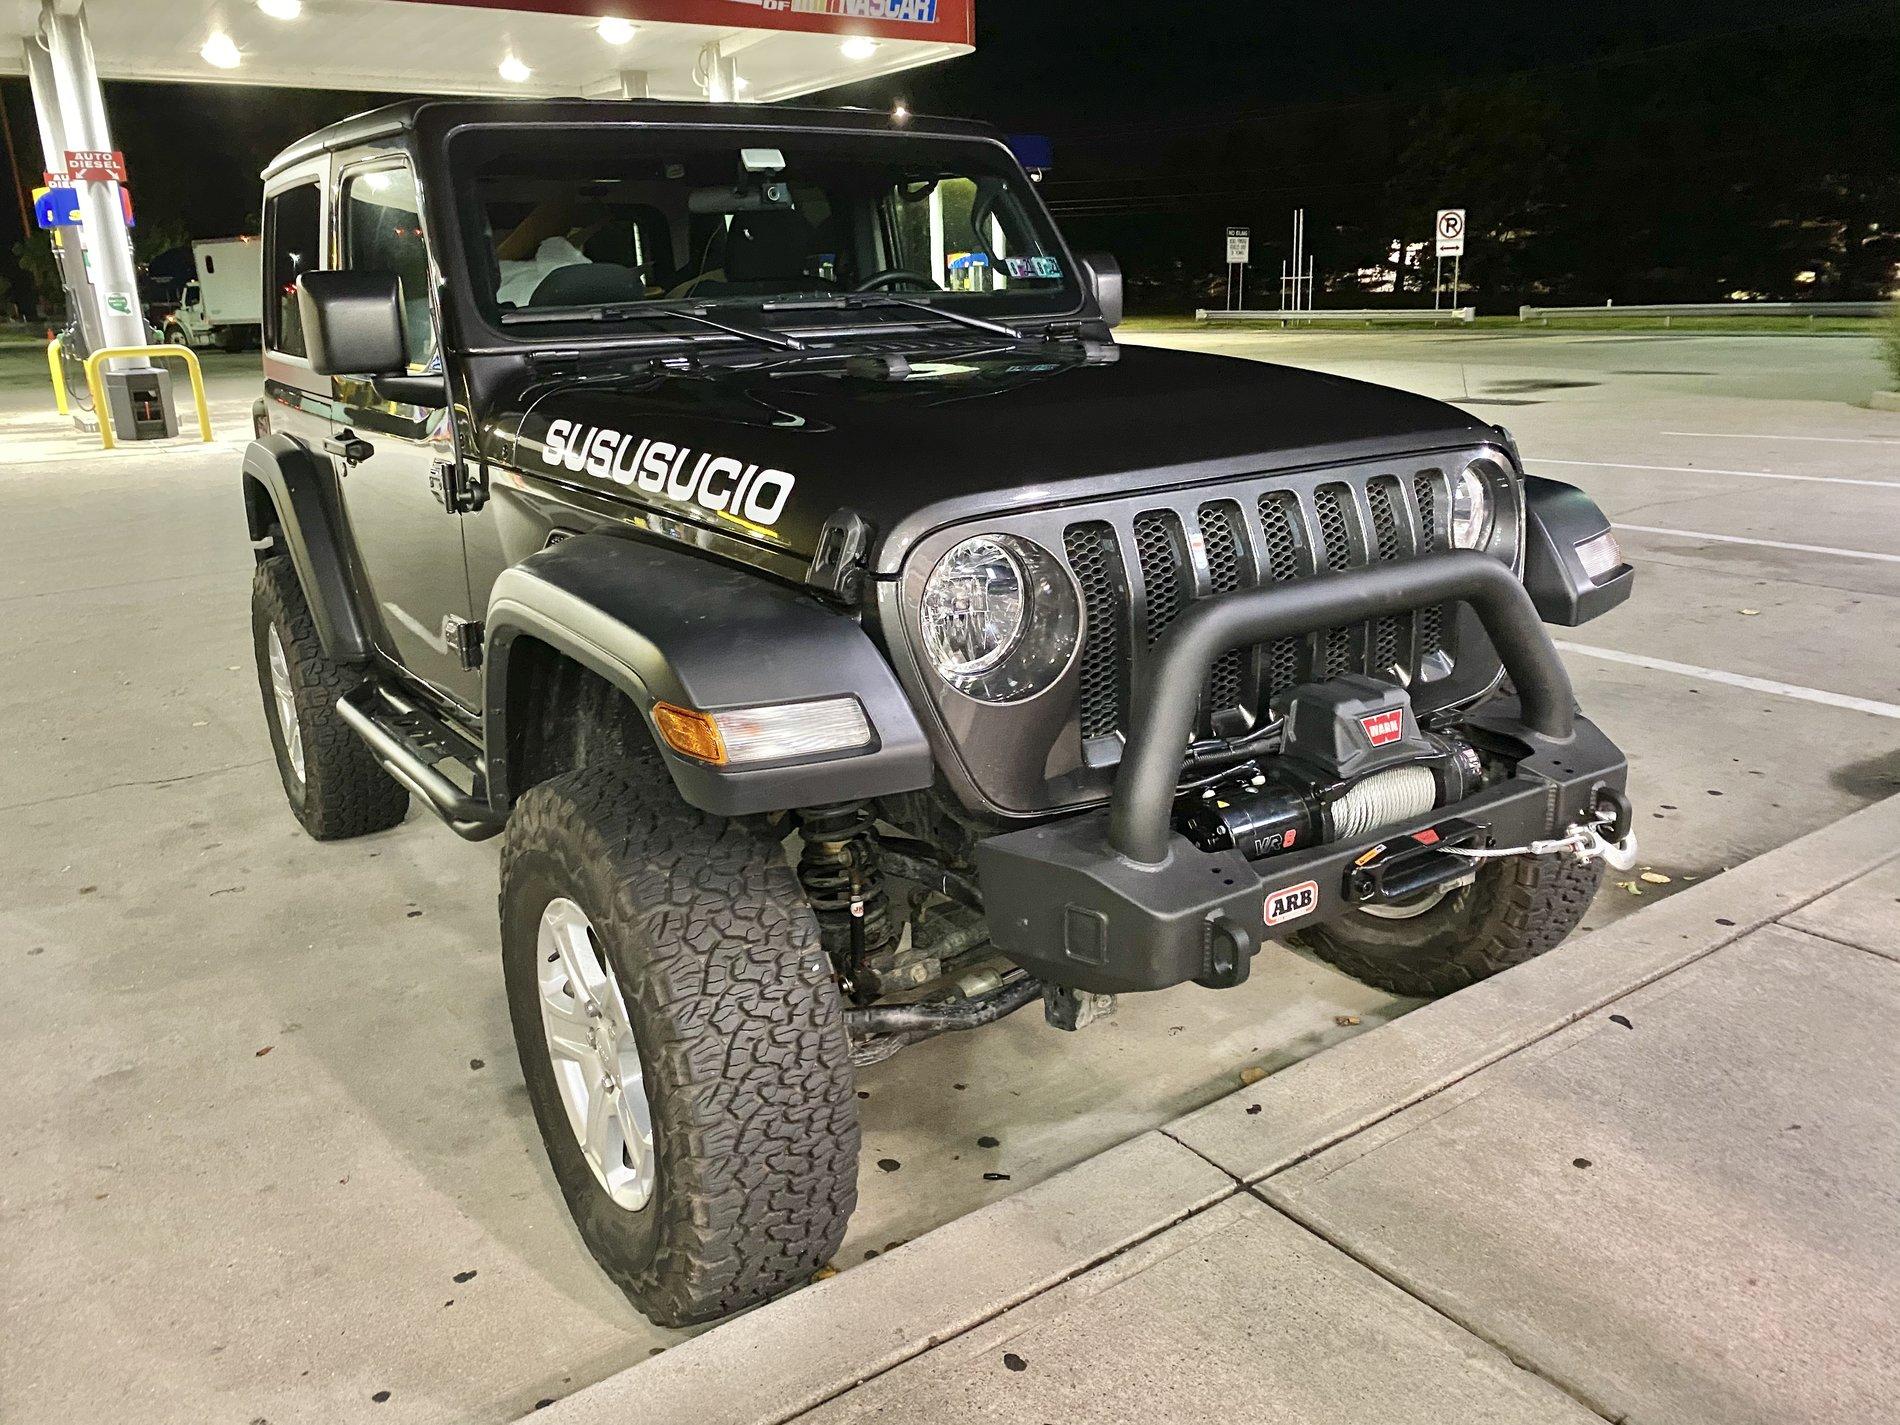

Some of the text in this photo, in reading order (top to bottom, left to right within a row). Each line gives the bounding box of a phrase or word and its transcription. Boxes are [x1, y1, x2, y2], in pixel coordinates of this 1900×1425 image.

[763, 0, 790, 11] OF
[74, 152, 113, 161] AUTO
[69, 160, 121, 169] DIESEL
[542, 419, 796, 525] SUSUSUCIO
[1368, 720, 1399, 737] WARN
[1271, 889, 1313, 918] ARB
